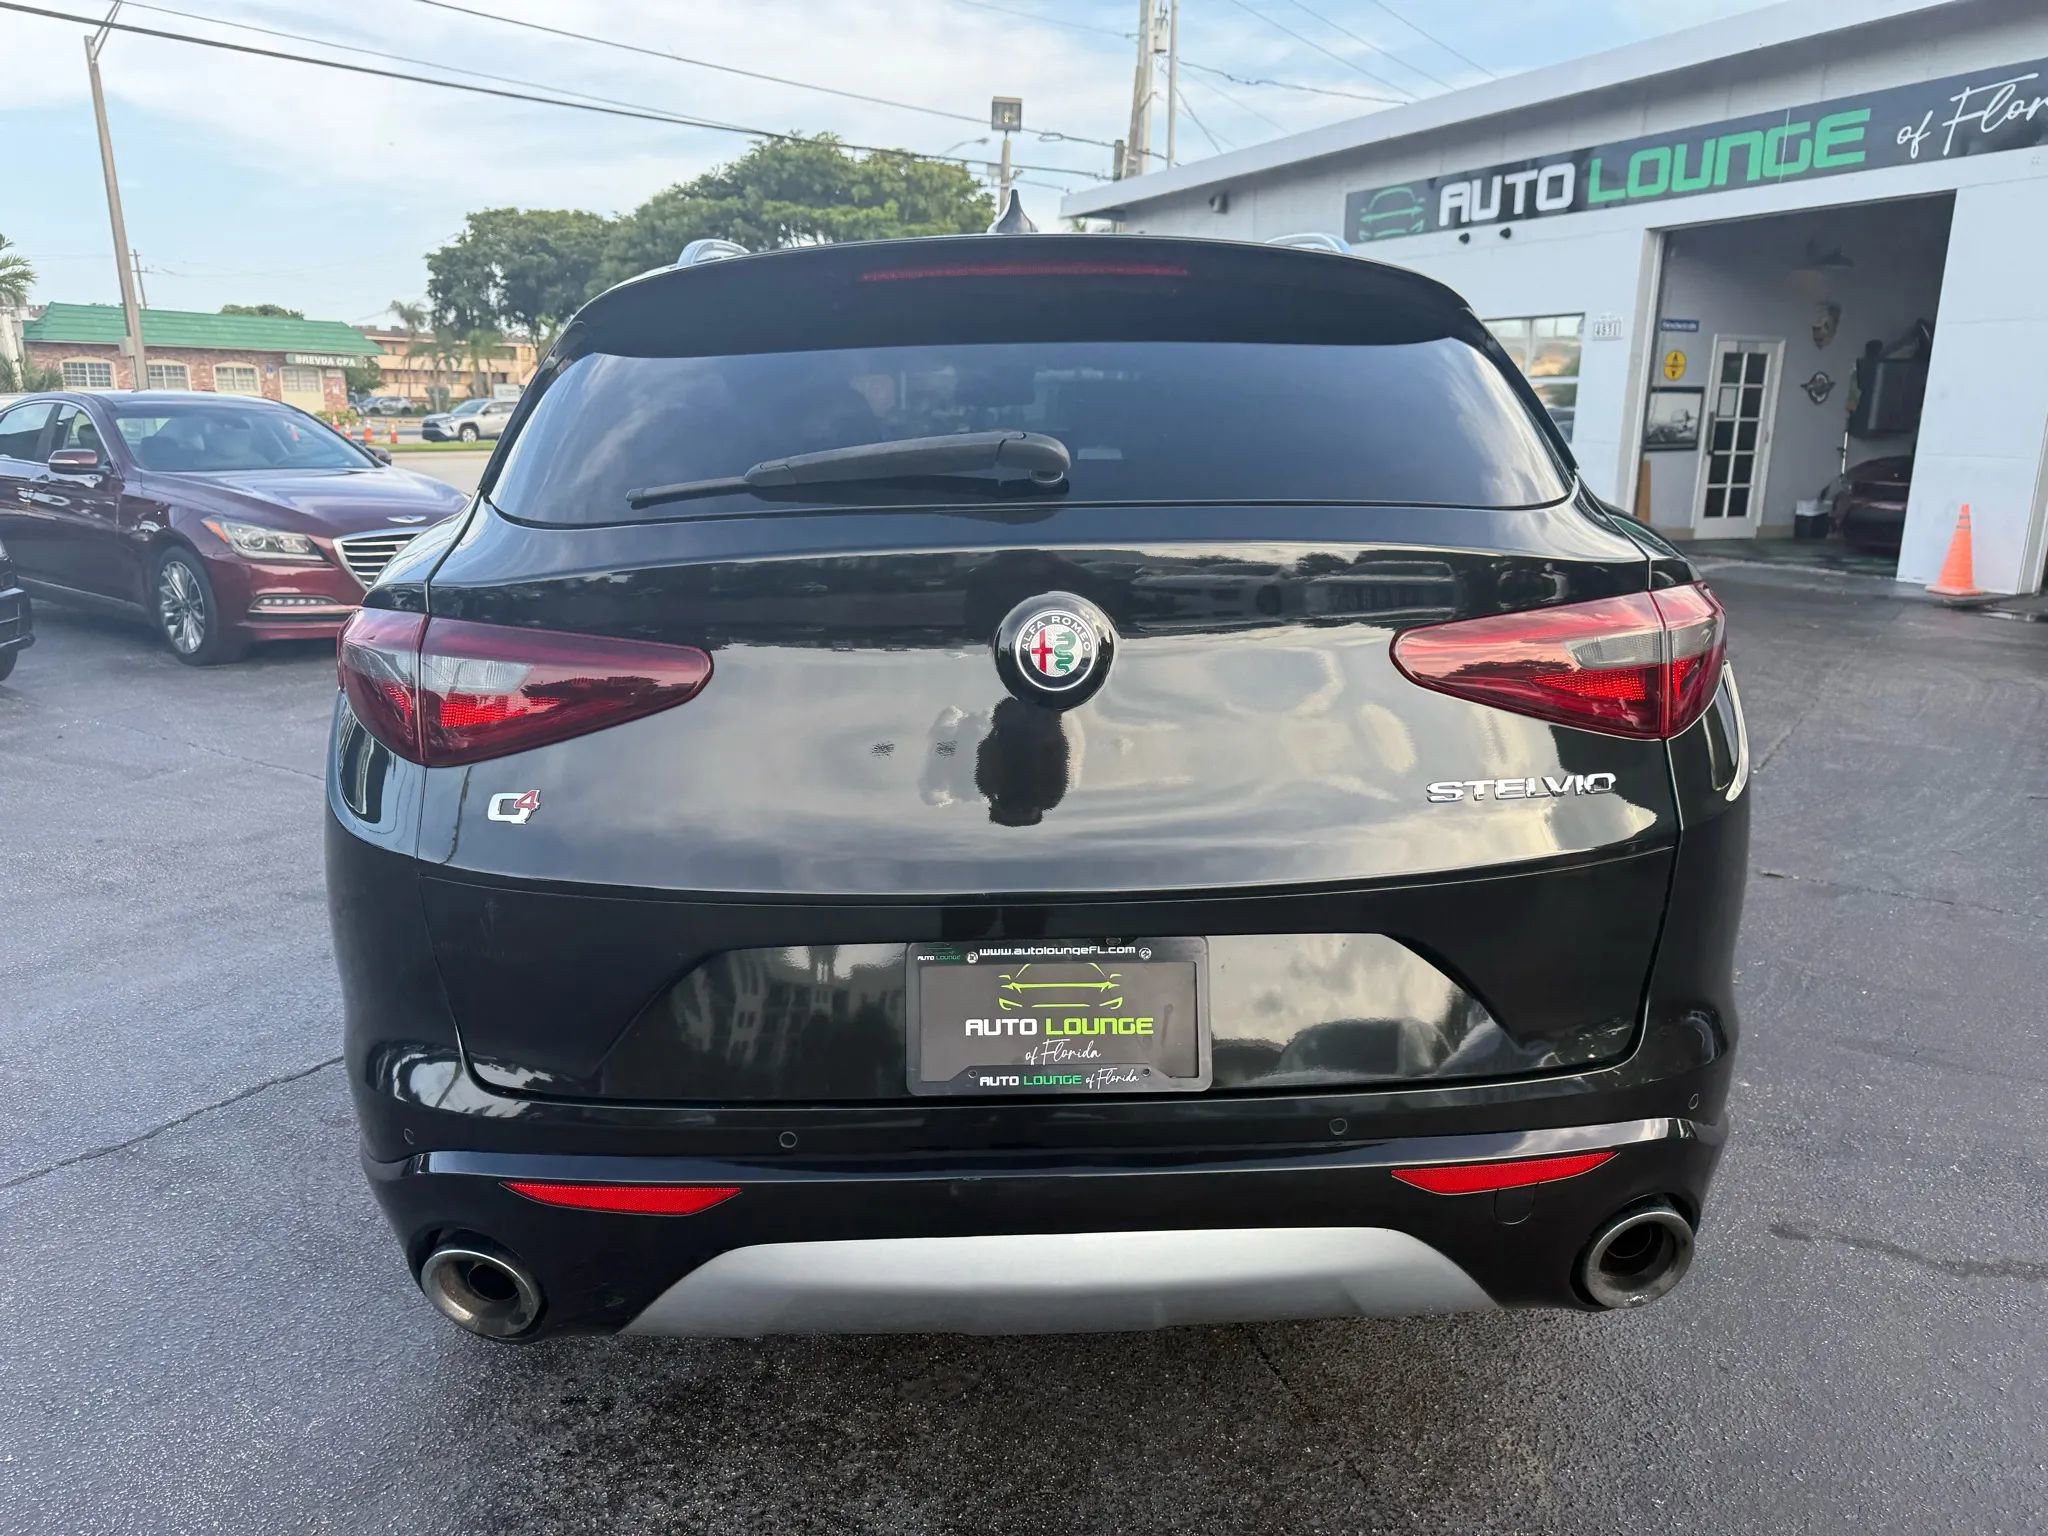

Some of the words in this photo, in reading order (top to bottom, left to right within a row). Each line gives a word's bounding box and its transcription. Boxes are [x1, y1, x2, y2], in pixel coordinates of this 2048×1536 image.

[1439, 162, 1576, 226] AUTO
[1587, 108, 1871, 204] LOUNGE
[1896, 110, 1935, 159] of
[1022, 621, 1046, 651] ALFA
[1051, 616, 1091, 652] ROMEO
[1426, 773, 1617, 802] STELVIO
[487, 789, 541, 825] Q4
[965, 1018, 1037, 1036] AUTO
[1045, 1017, 1154, 1035] LOUNGE
[1025, 1046, 1039, 1065] of
[1040, 1038, 1101, 1066] Florida
[979, 1076, 1020, 1086] AUTO
[1023, 1074, 1082, 1085] LOUNGE
[1085, 1073, 1095, 1089] of
[1096, 1067, 1140, 1090] Florida
